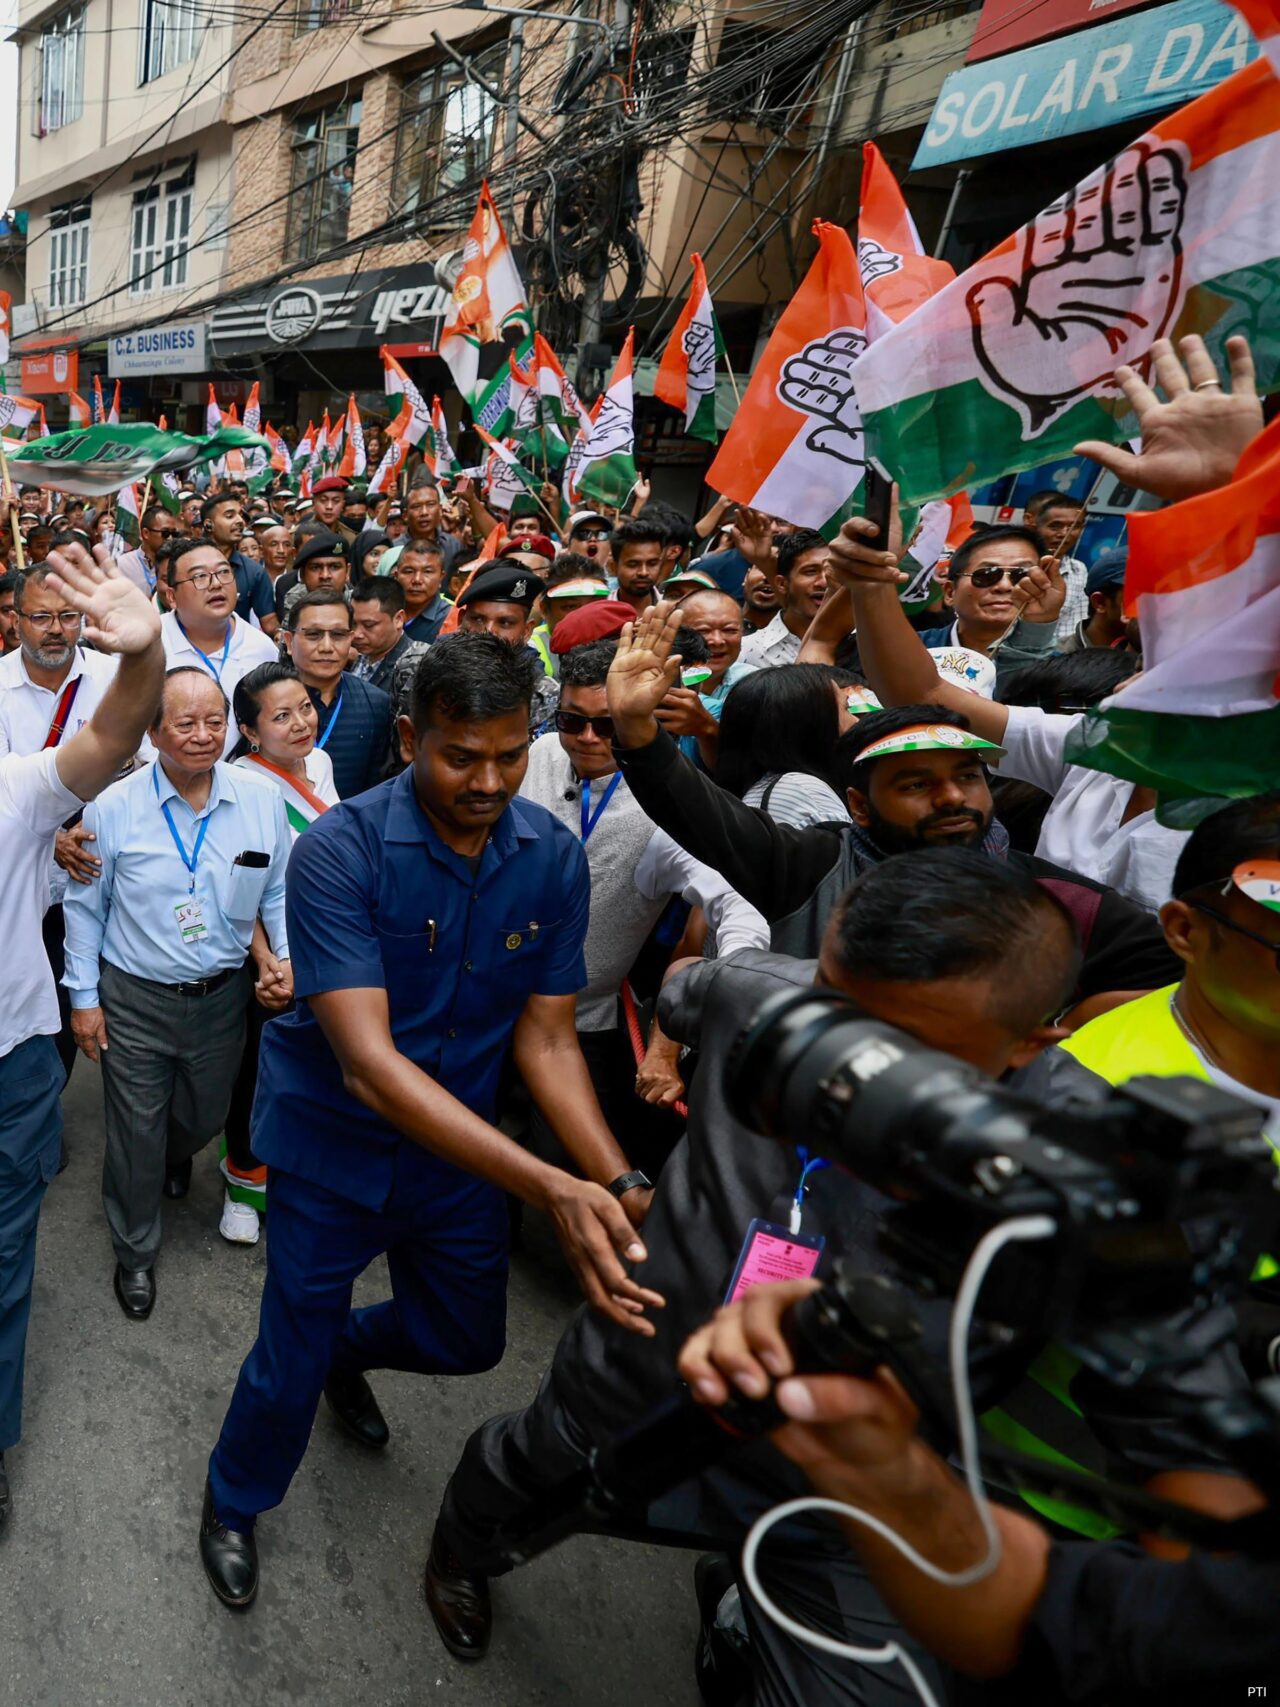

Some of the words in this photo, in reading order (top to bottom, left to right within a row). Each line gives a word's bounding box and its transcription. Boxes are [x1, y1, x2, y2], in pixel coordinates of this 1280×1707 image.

[925, 43, 1134, 148] SOLAR
[1143, 13, 1250, 93] DA
[115, 339, 136, 355] C.Z.
[137, 329, 195, 352] BUSINESS
